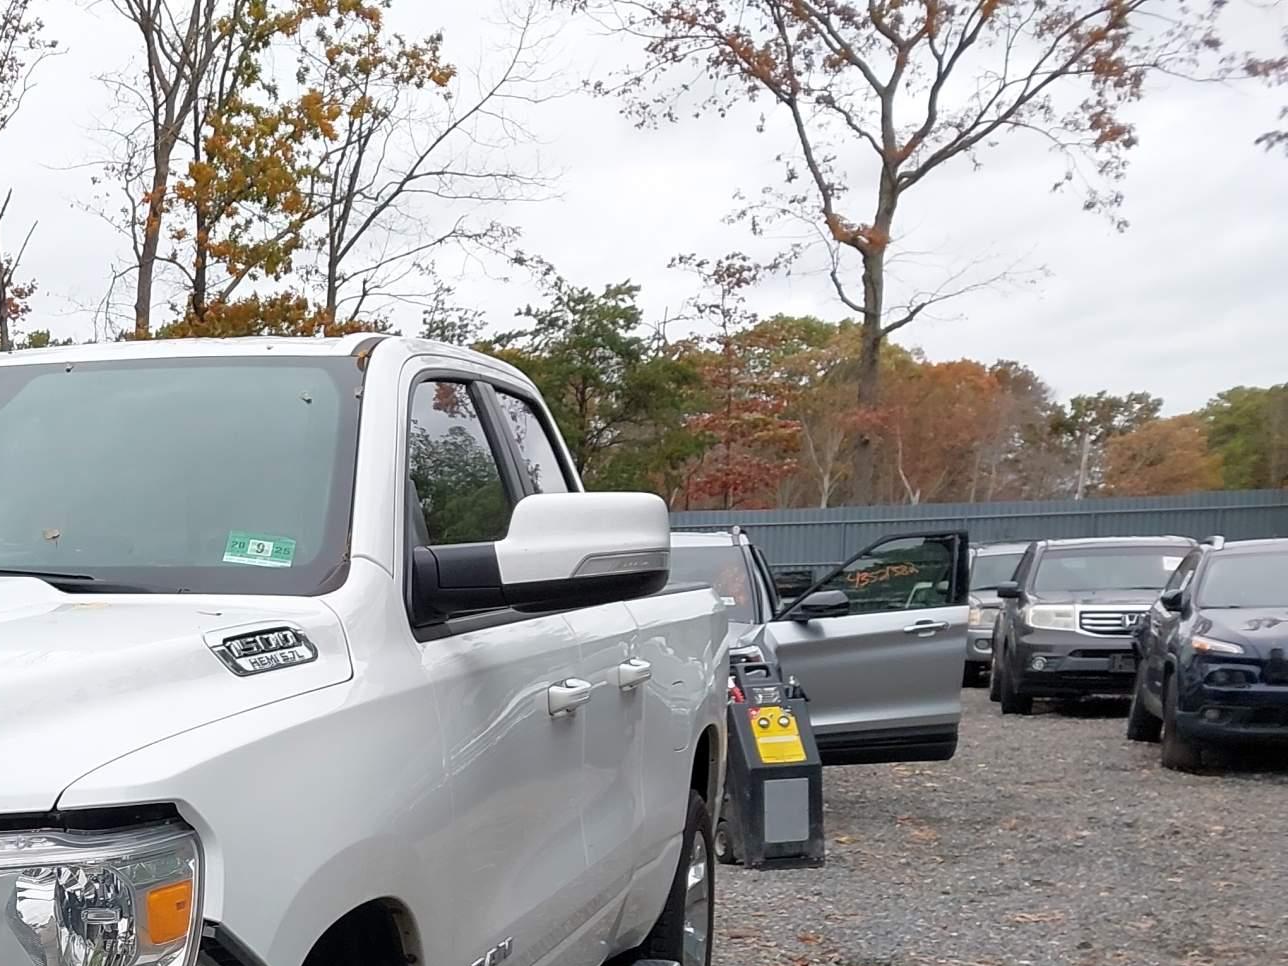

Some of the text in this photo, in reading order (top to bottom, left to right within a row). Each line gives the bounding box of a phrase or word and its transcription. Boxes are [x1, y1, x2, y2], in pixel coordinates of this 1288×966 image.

[254, 541, 266, 554] 9
[225, 630, 297, 658] 1500
[248, 653, 280, 671] HEMI
